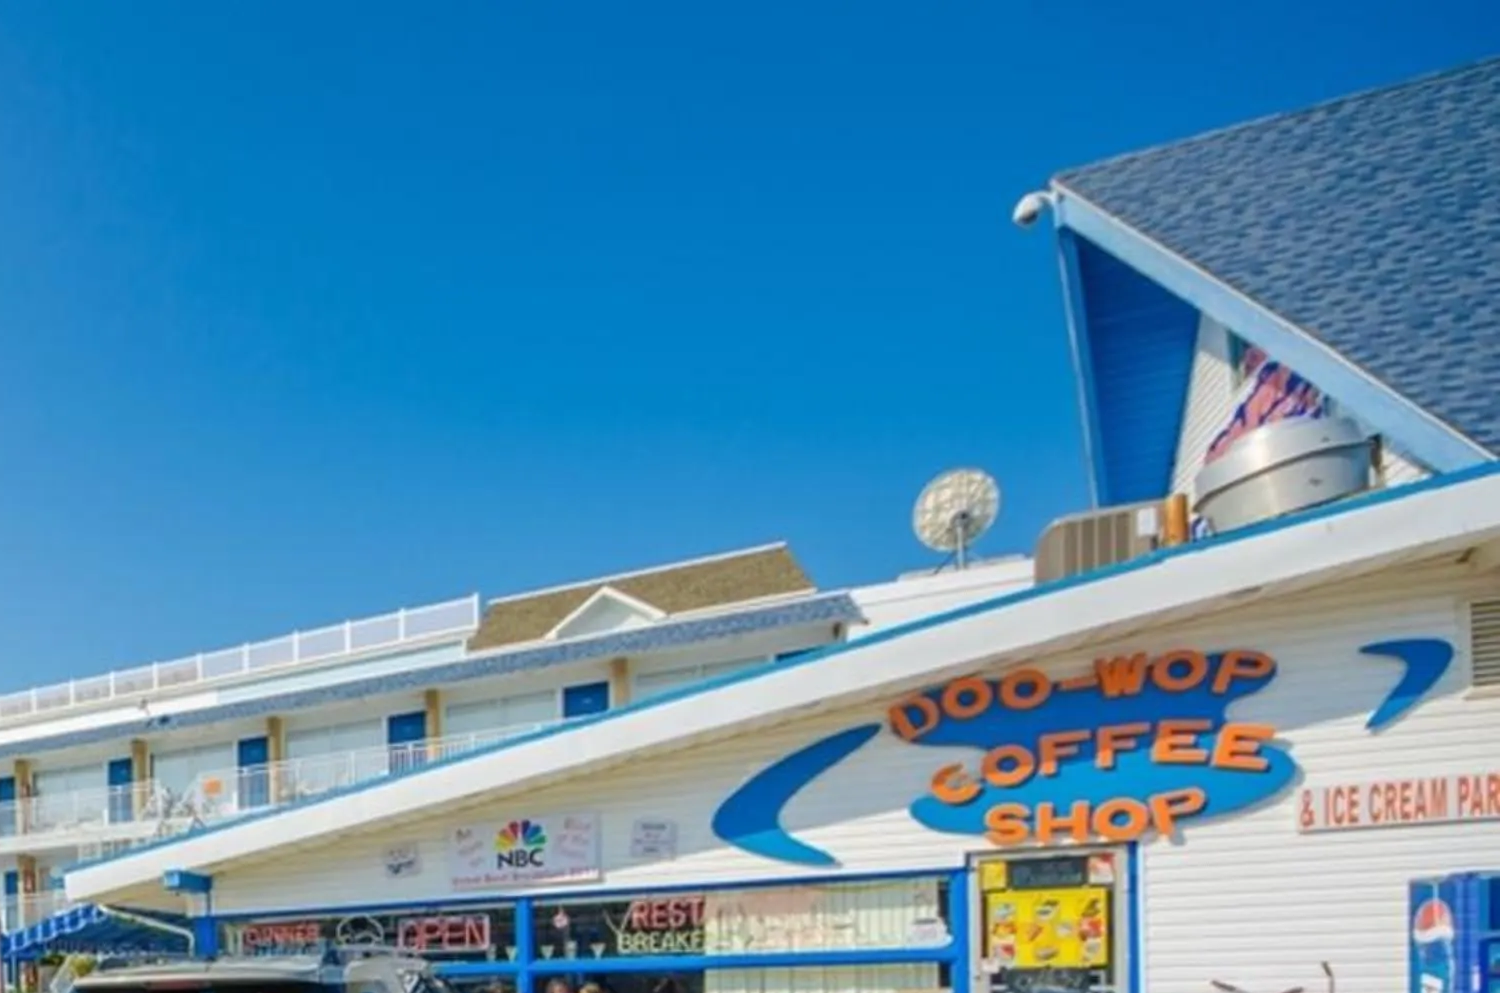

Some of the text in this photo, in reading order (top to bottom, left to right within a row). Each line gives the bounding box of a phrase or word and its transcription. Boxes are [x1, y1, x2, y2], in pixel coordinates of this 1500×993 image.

[887, 648, 1276, 741] DOO-WOP
[930, 719, 1276, 804] COFFEE
[984, 786, 1206, 847] SHOP
[1301, 789, 1316, 828] &
[1323, 784, 1361, 826] ICE
[1367, 777, 1448, 823] CREAM
[496, 848, 545, 870] NBC
[403, 916, 486, 953] OPEN
